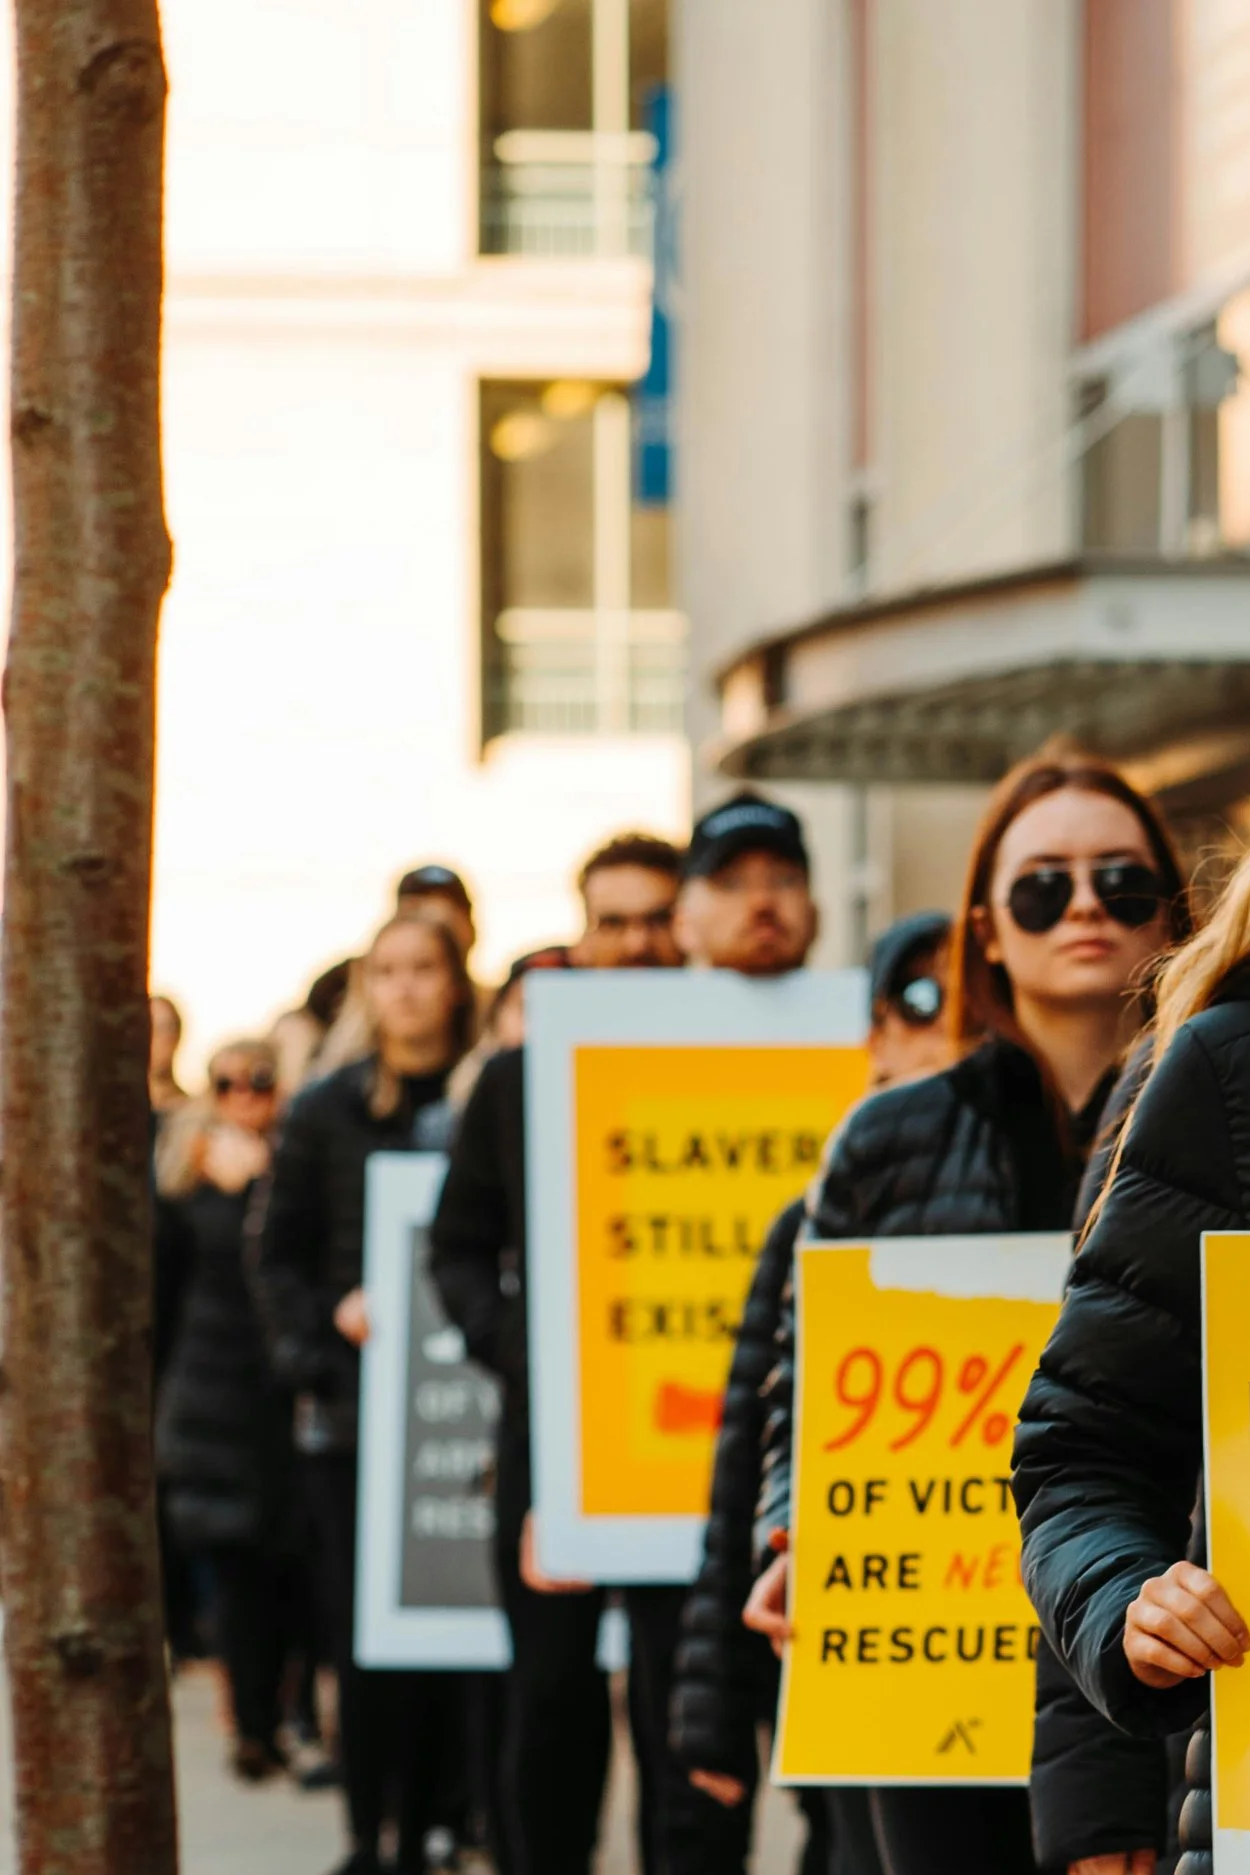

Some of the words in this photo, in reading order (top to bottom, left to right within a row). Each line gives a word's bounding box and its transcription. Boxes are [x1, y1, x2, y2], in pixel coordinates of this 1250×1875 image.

[607, 1129, 819, 1176] SLAVER
[607, 1214, 757, 1259] STILL
[607, 1298, 731, 1344] EXIS
[824, 1344, 1026, 1453] 99%
[826, 1479, 889, 1517] OF
[908, 1476, 1011, 1515] VICT
[824, 1553, 922, 1591] ARE
[942, 1542, 1027, 1592] NE
